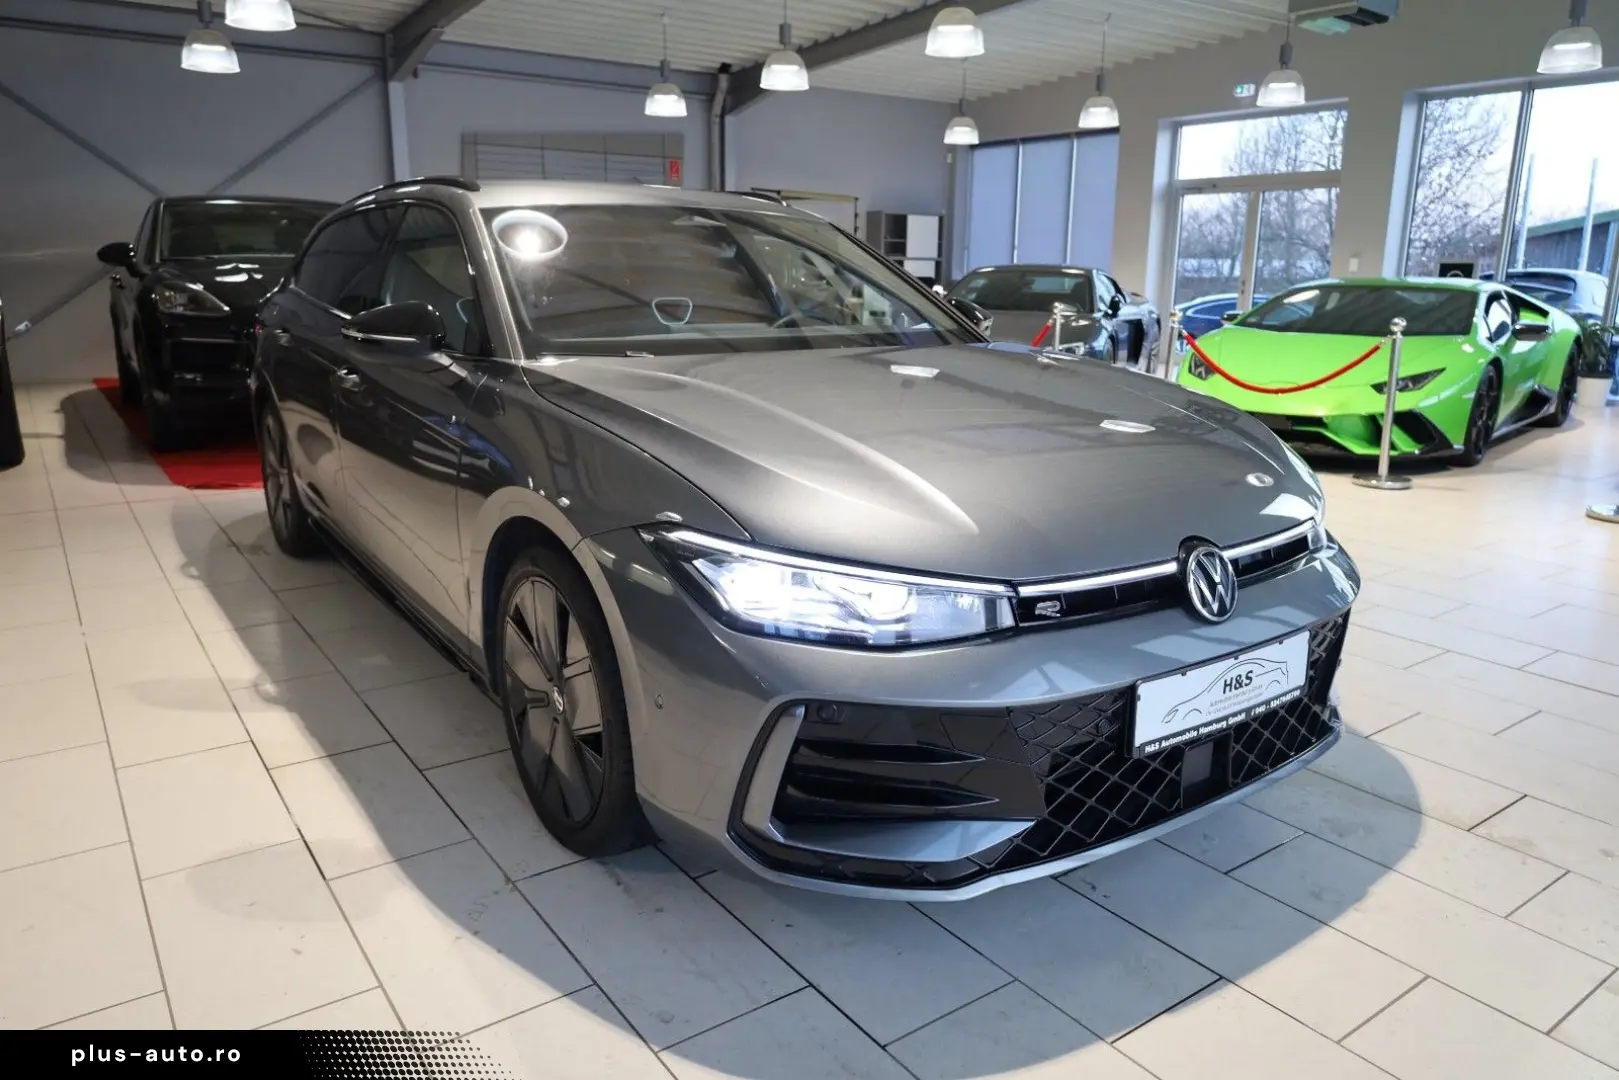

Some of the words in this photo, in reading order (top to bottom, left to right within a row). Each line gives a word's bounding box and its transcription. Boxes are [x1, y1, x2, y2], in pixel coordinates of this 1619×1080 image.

[1223, 670, 1254, 694] H&S
[1144, 742, 1160, 753] H&S
[1160, 729, 1198, 748] Automobile
[1199, 720, 1227, 735] Hamburg
[1228, 712, 1246, 724] GmbH
